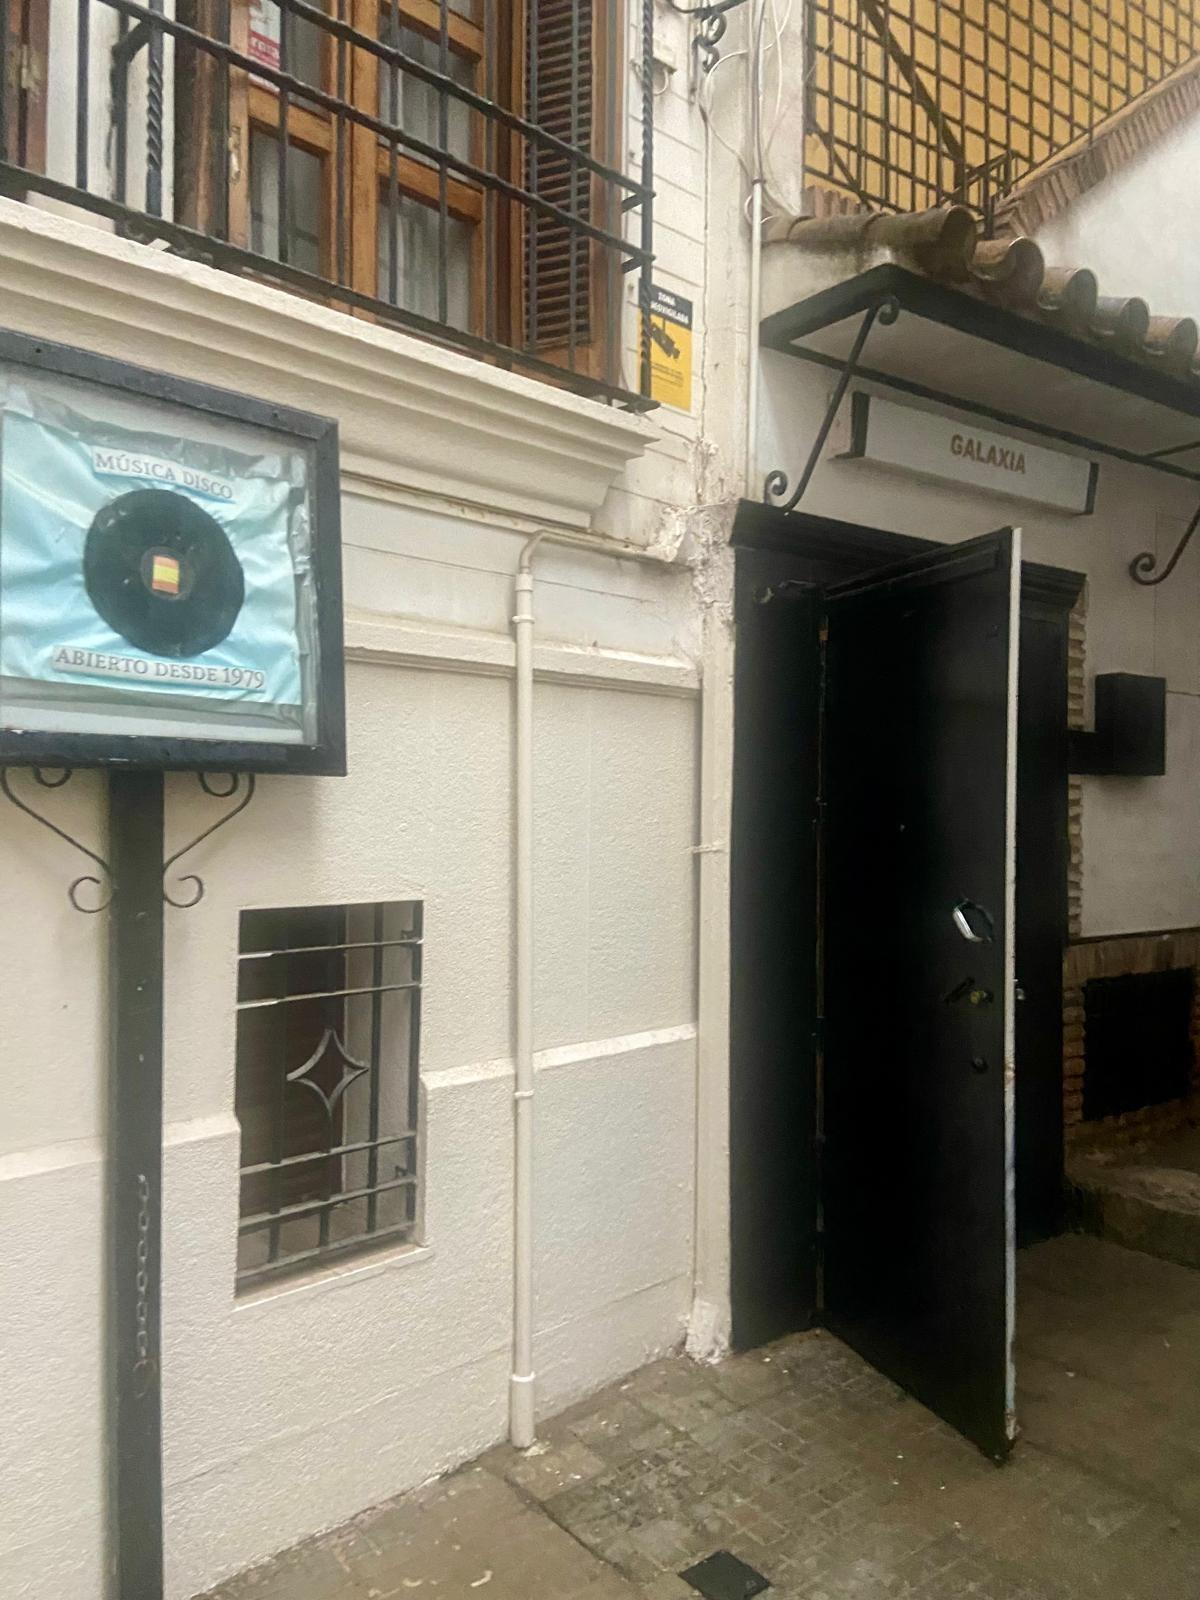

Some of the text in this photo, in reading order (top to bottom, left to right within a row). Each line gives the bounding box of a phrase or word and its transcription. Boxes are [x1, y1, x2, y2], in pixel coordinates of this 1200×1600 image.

[951, 434, 1025, 474] GALAXIA
[96, 454, 233, 499] MÚSICA DISCO
[55, 649, 265, 689] ABIERTO DESDE 1979
